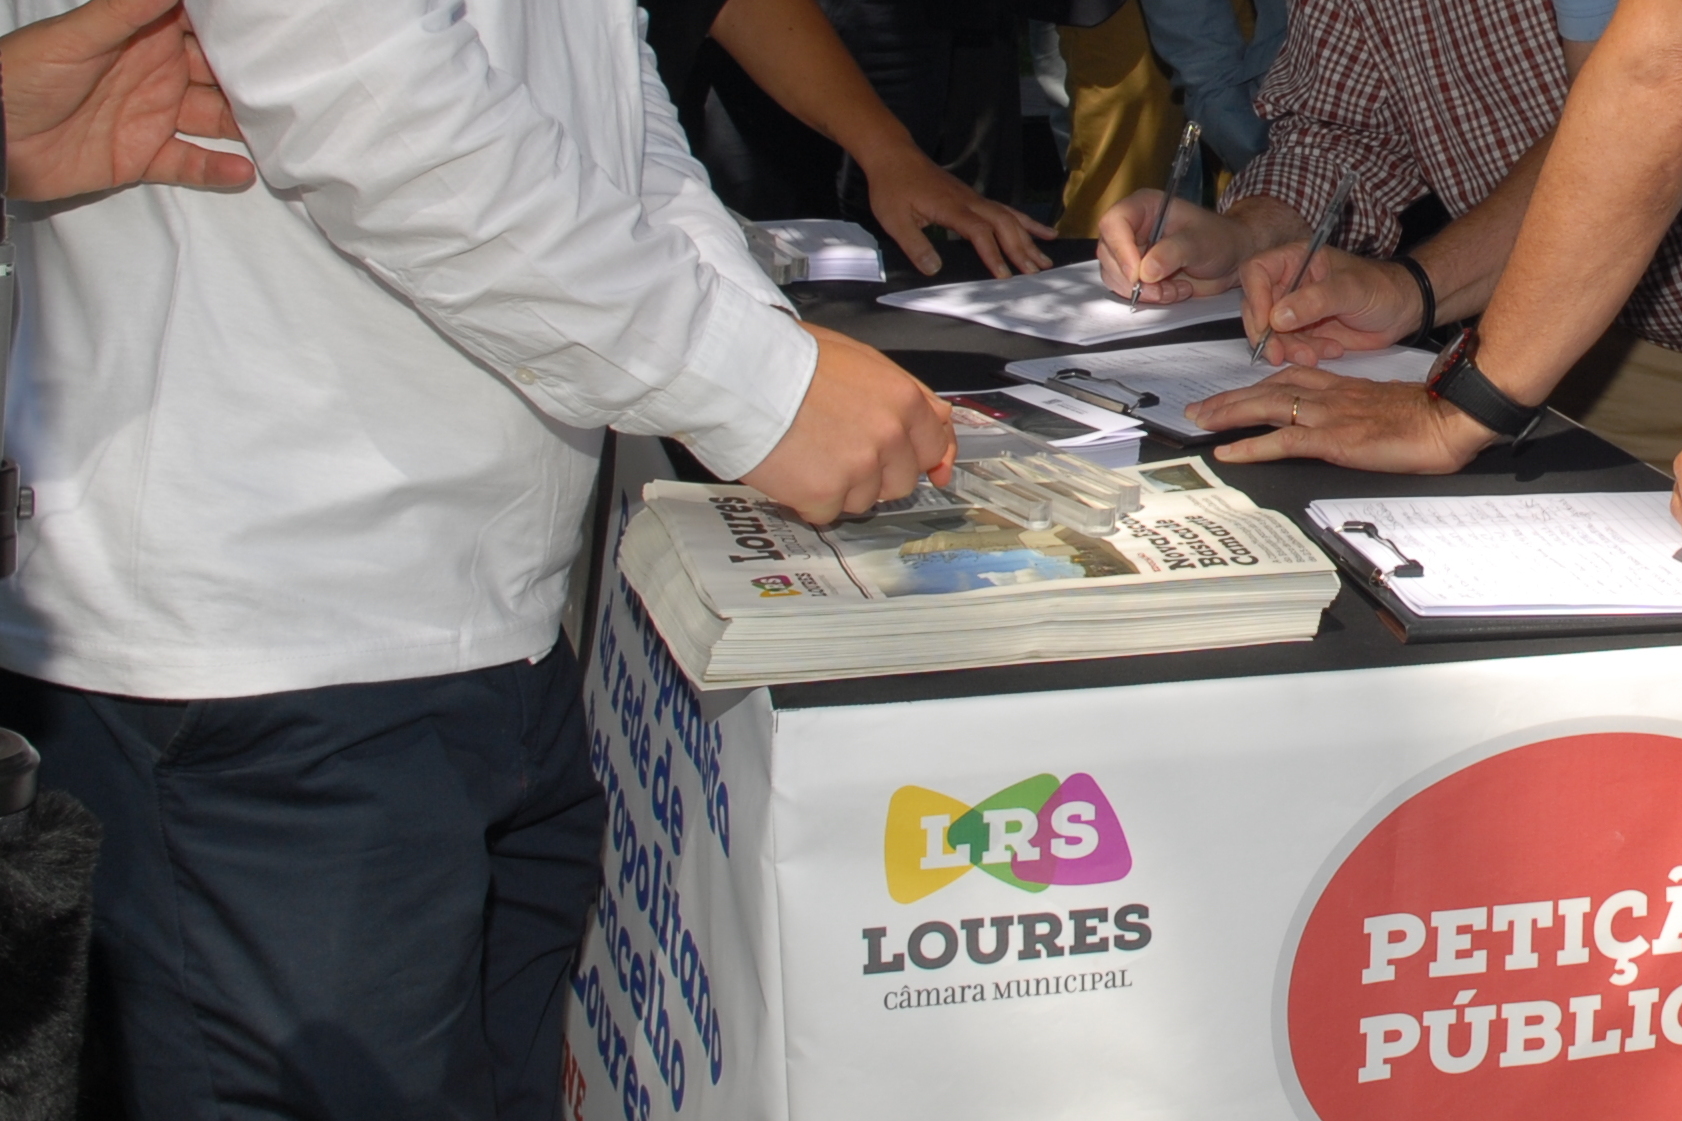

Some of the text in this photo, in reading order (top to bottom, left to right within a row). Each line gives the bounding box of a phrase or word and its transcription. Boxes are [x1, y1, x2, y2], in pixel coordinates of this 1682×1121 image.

[708, 496, 786, 563] Loures
[1148, 527, 1197, 571] Nova
[612, 650, 651, 789] rede
[652, 737, 683, 856] de
[920, 800, 1100, 870] LRS
[862, 903, 1153, 975] LOURES
[597, 882, 685, 1112] oncelho
